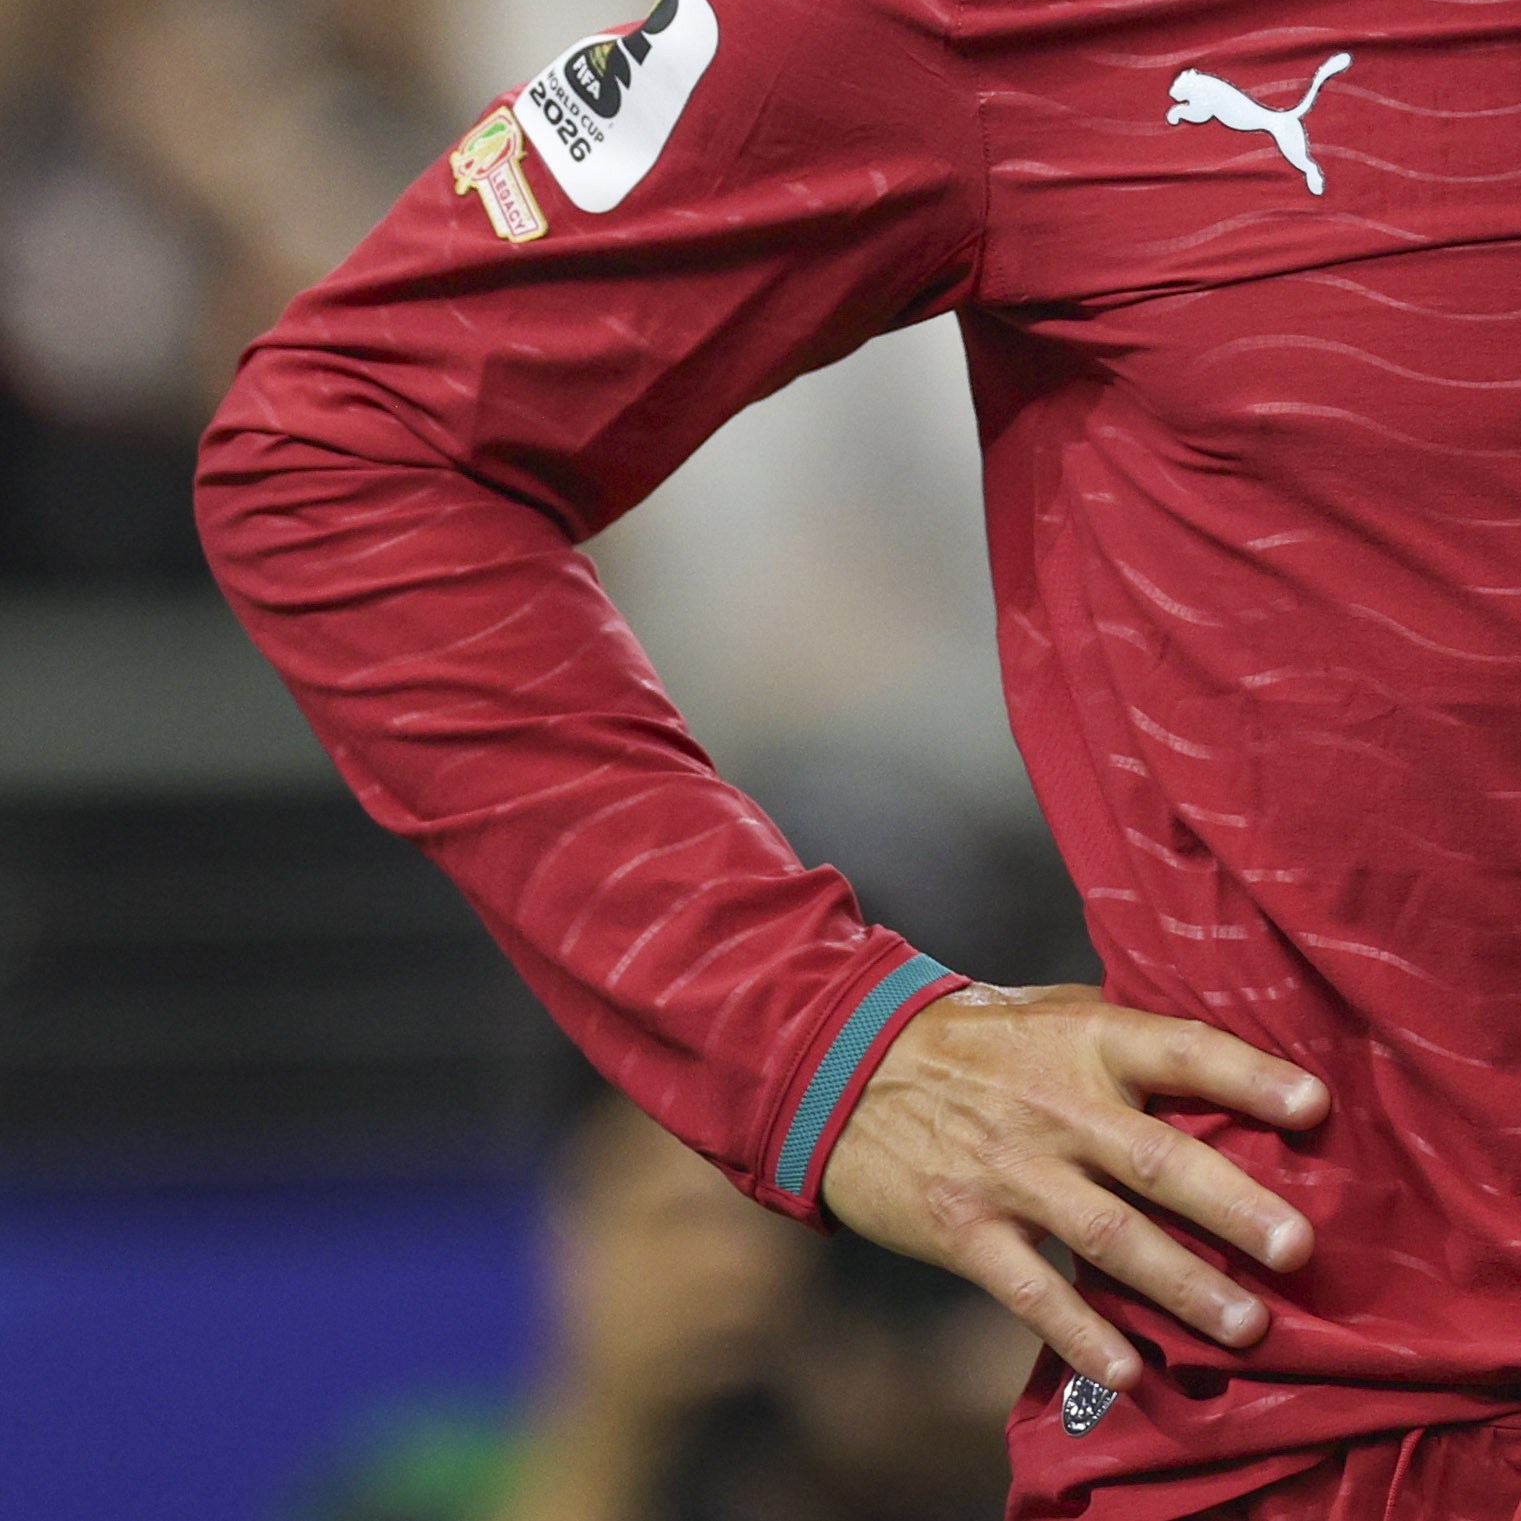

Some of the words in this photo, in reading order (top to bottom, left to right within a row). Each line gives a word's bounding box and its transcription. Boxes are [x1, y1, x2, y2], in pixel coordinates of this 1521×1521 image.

[547, 68, 581, 117] WORLD
[580, 114, 605, 143] CUP
[572, 54, 602, 101] FIFA
[529, 81, 592, 163] 2026
[492, 171, 525, 230] LEGACY
